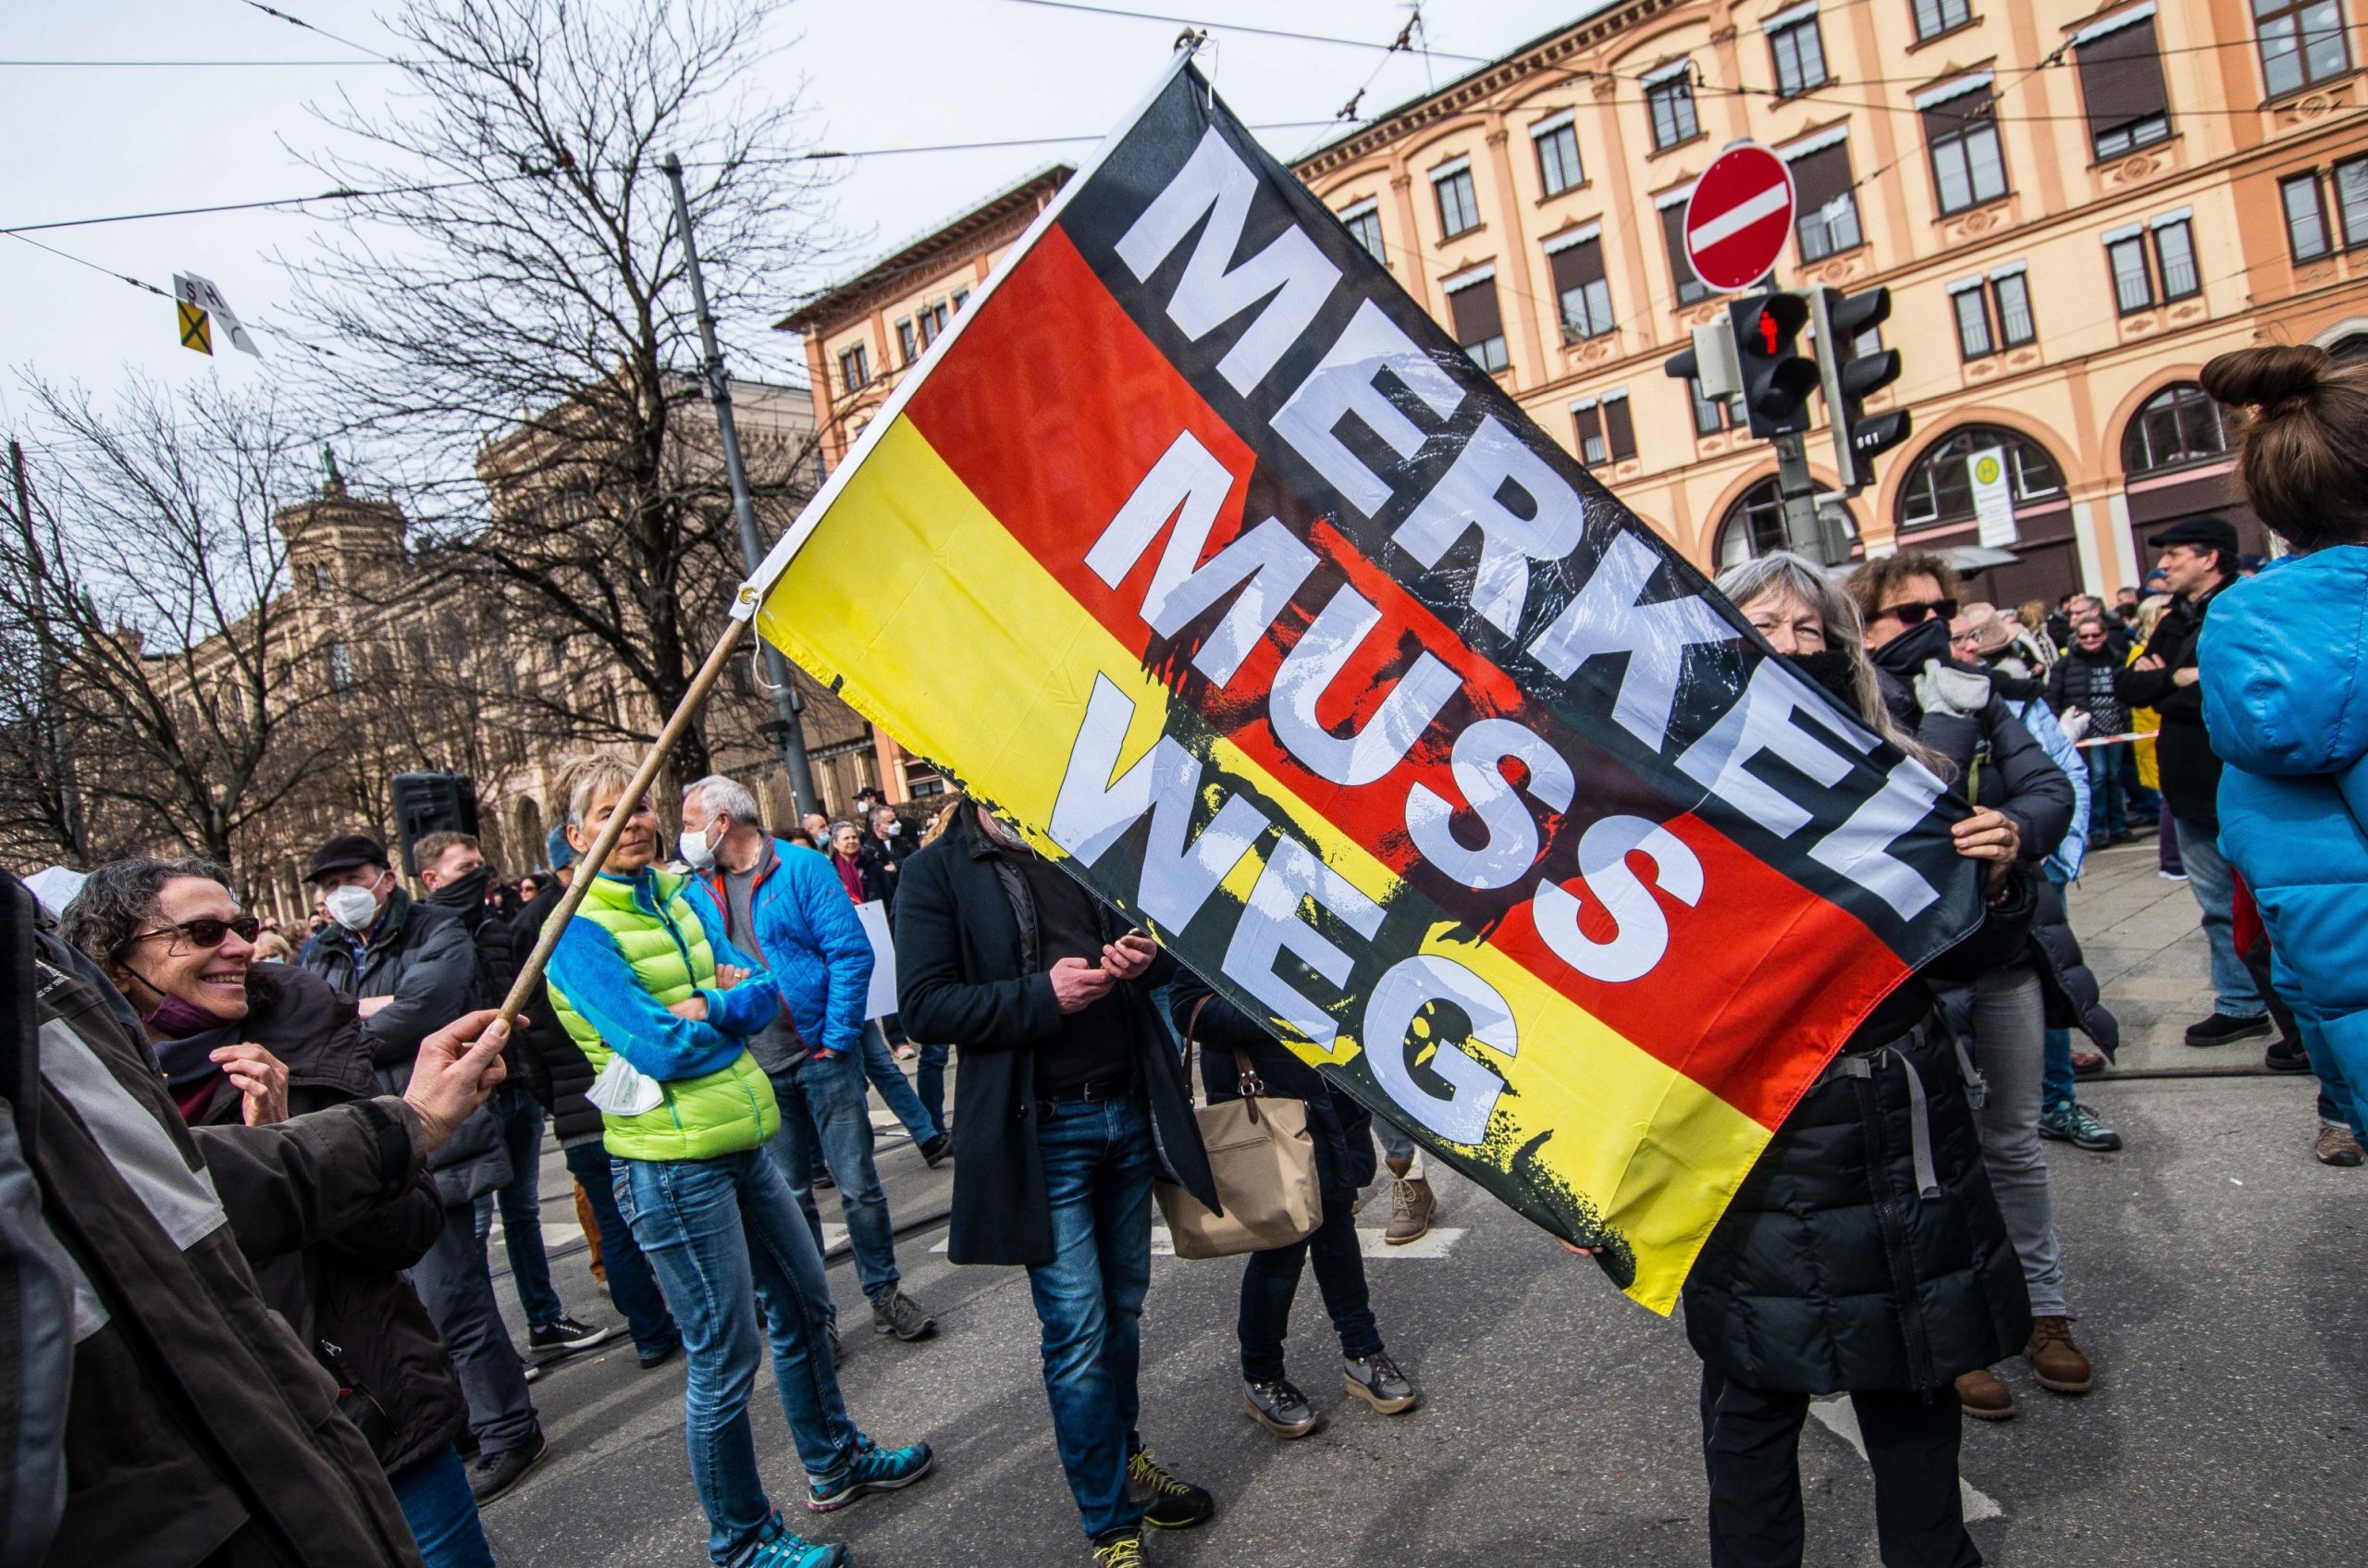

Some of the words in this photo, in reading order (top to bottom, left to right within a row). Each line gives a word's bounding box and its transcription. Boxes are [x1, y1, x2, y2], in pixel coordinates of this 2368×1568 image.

[1083, 427, 1705, 983] MUSS
[1114, 124, 1948, 922] MERKEL
[1048, 670, 1519, 1145] WEG
